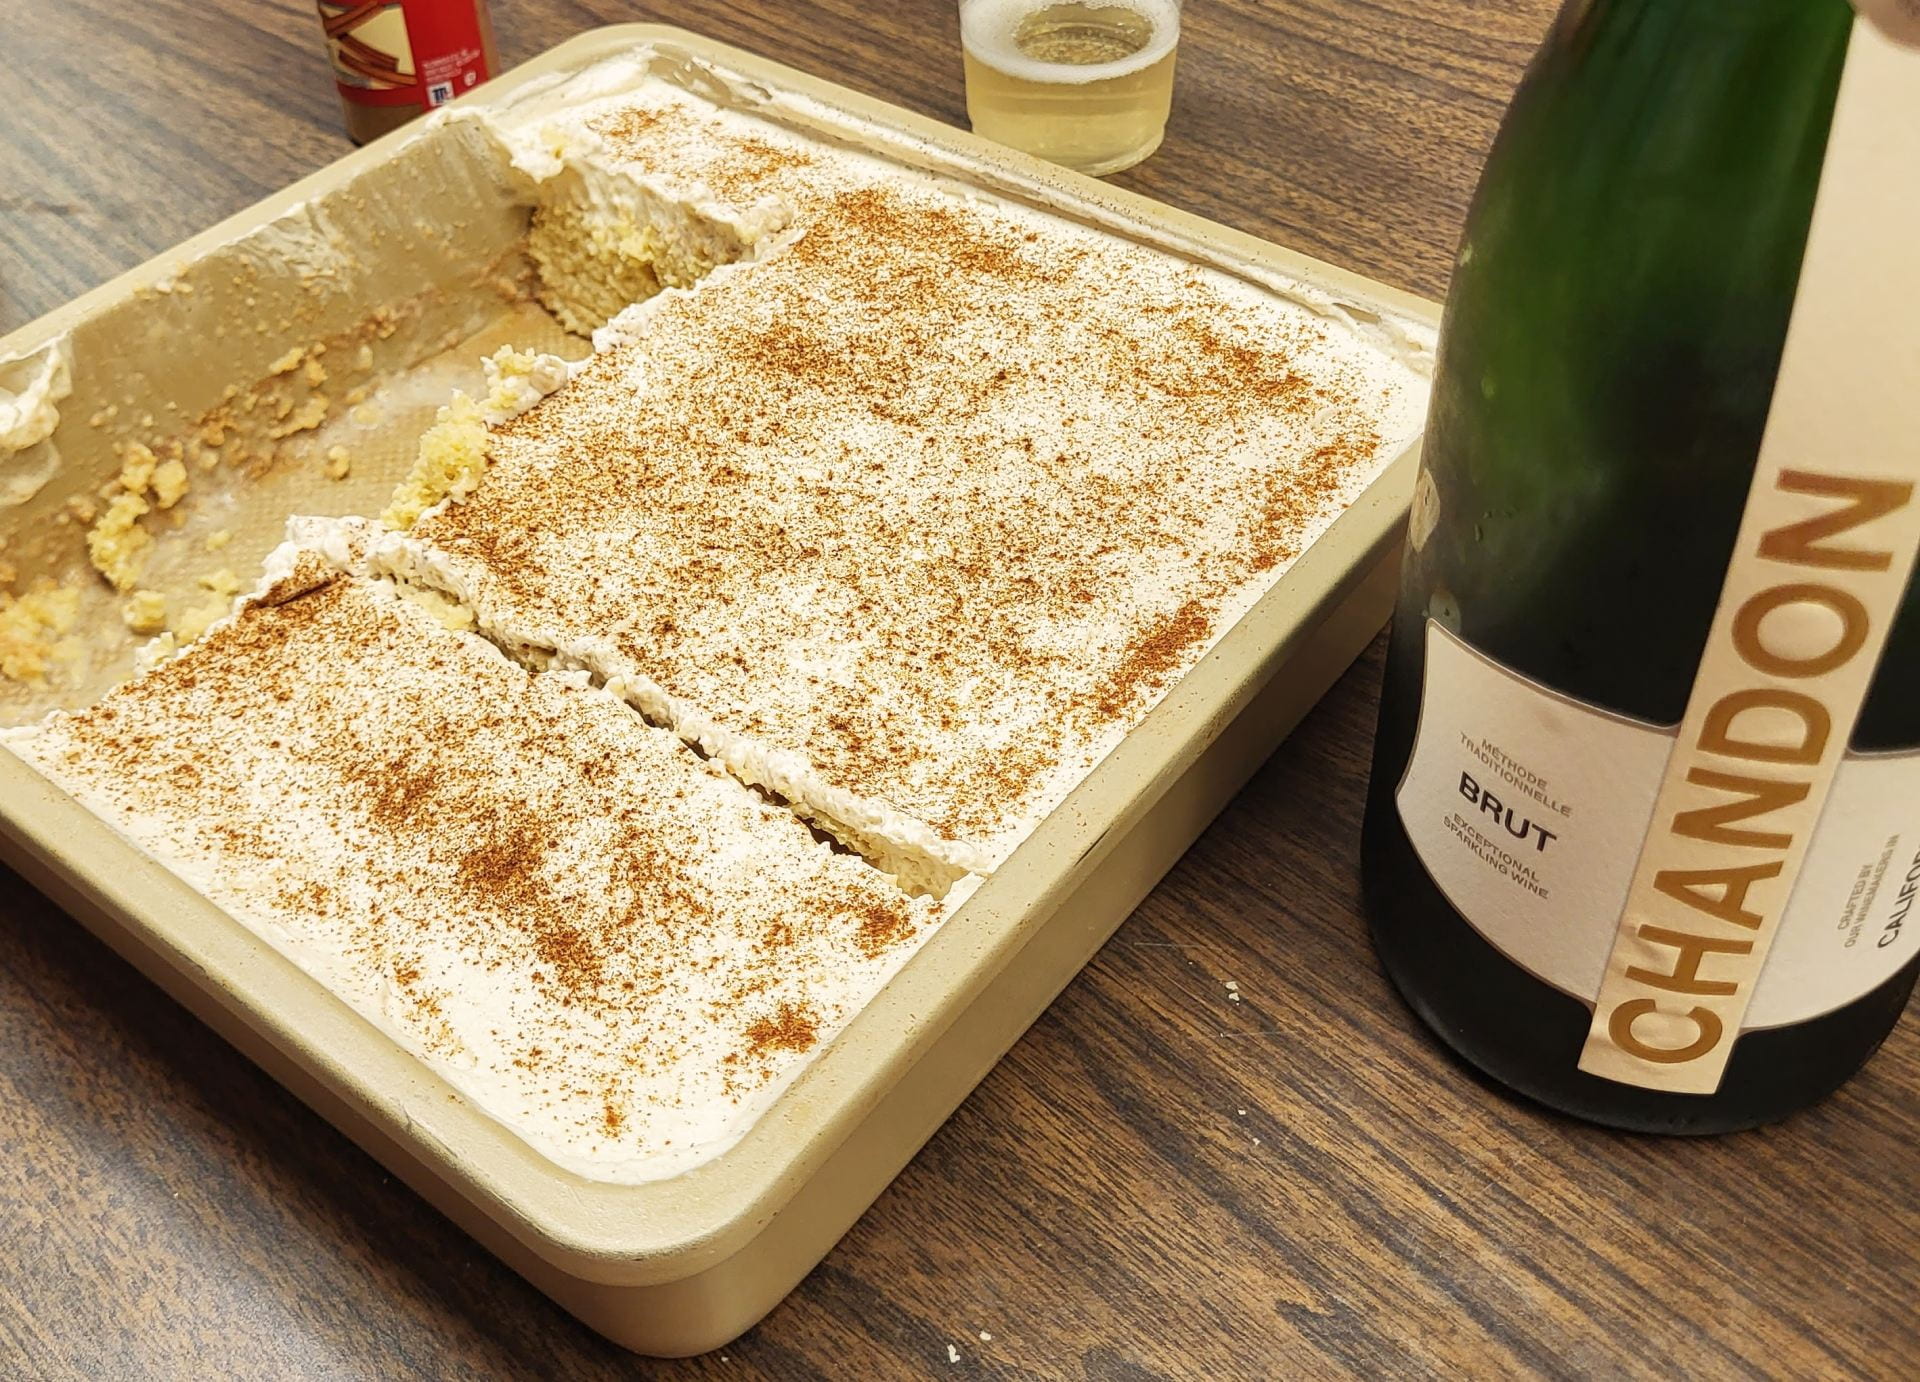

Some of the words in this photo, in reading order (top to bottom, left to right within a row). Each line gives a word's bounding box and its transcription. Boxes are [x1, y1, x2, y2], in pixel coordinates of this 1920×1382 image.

[1459, 731, 1573, 818] TRADITIONNELLE
[1481, 738, 1548, 791] MÉTHODE
[1609, 468, 1914, 1064] CHANDON
[1453, 813, 1540, 882] EXCEPTIONAL
[1458, 771, 1557, 852] BRUT
[1443, 816, 1508, 876] SPARKLING
[1511, 872, 1549, 899] WINE
[1837, 879, 1866, 930] CRAFTED
[1858, 864, 1873, 879] BY
[1844, 924, 1861, 948] OUR
